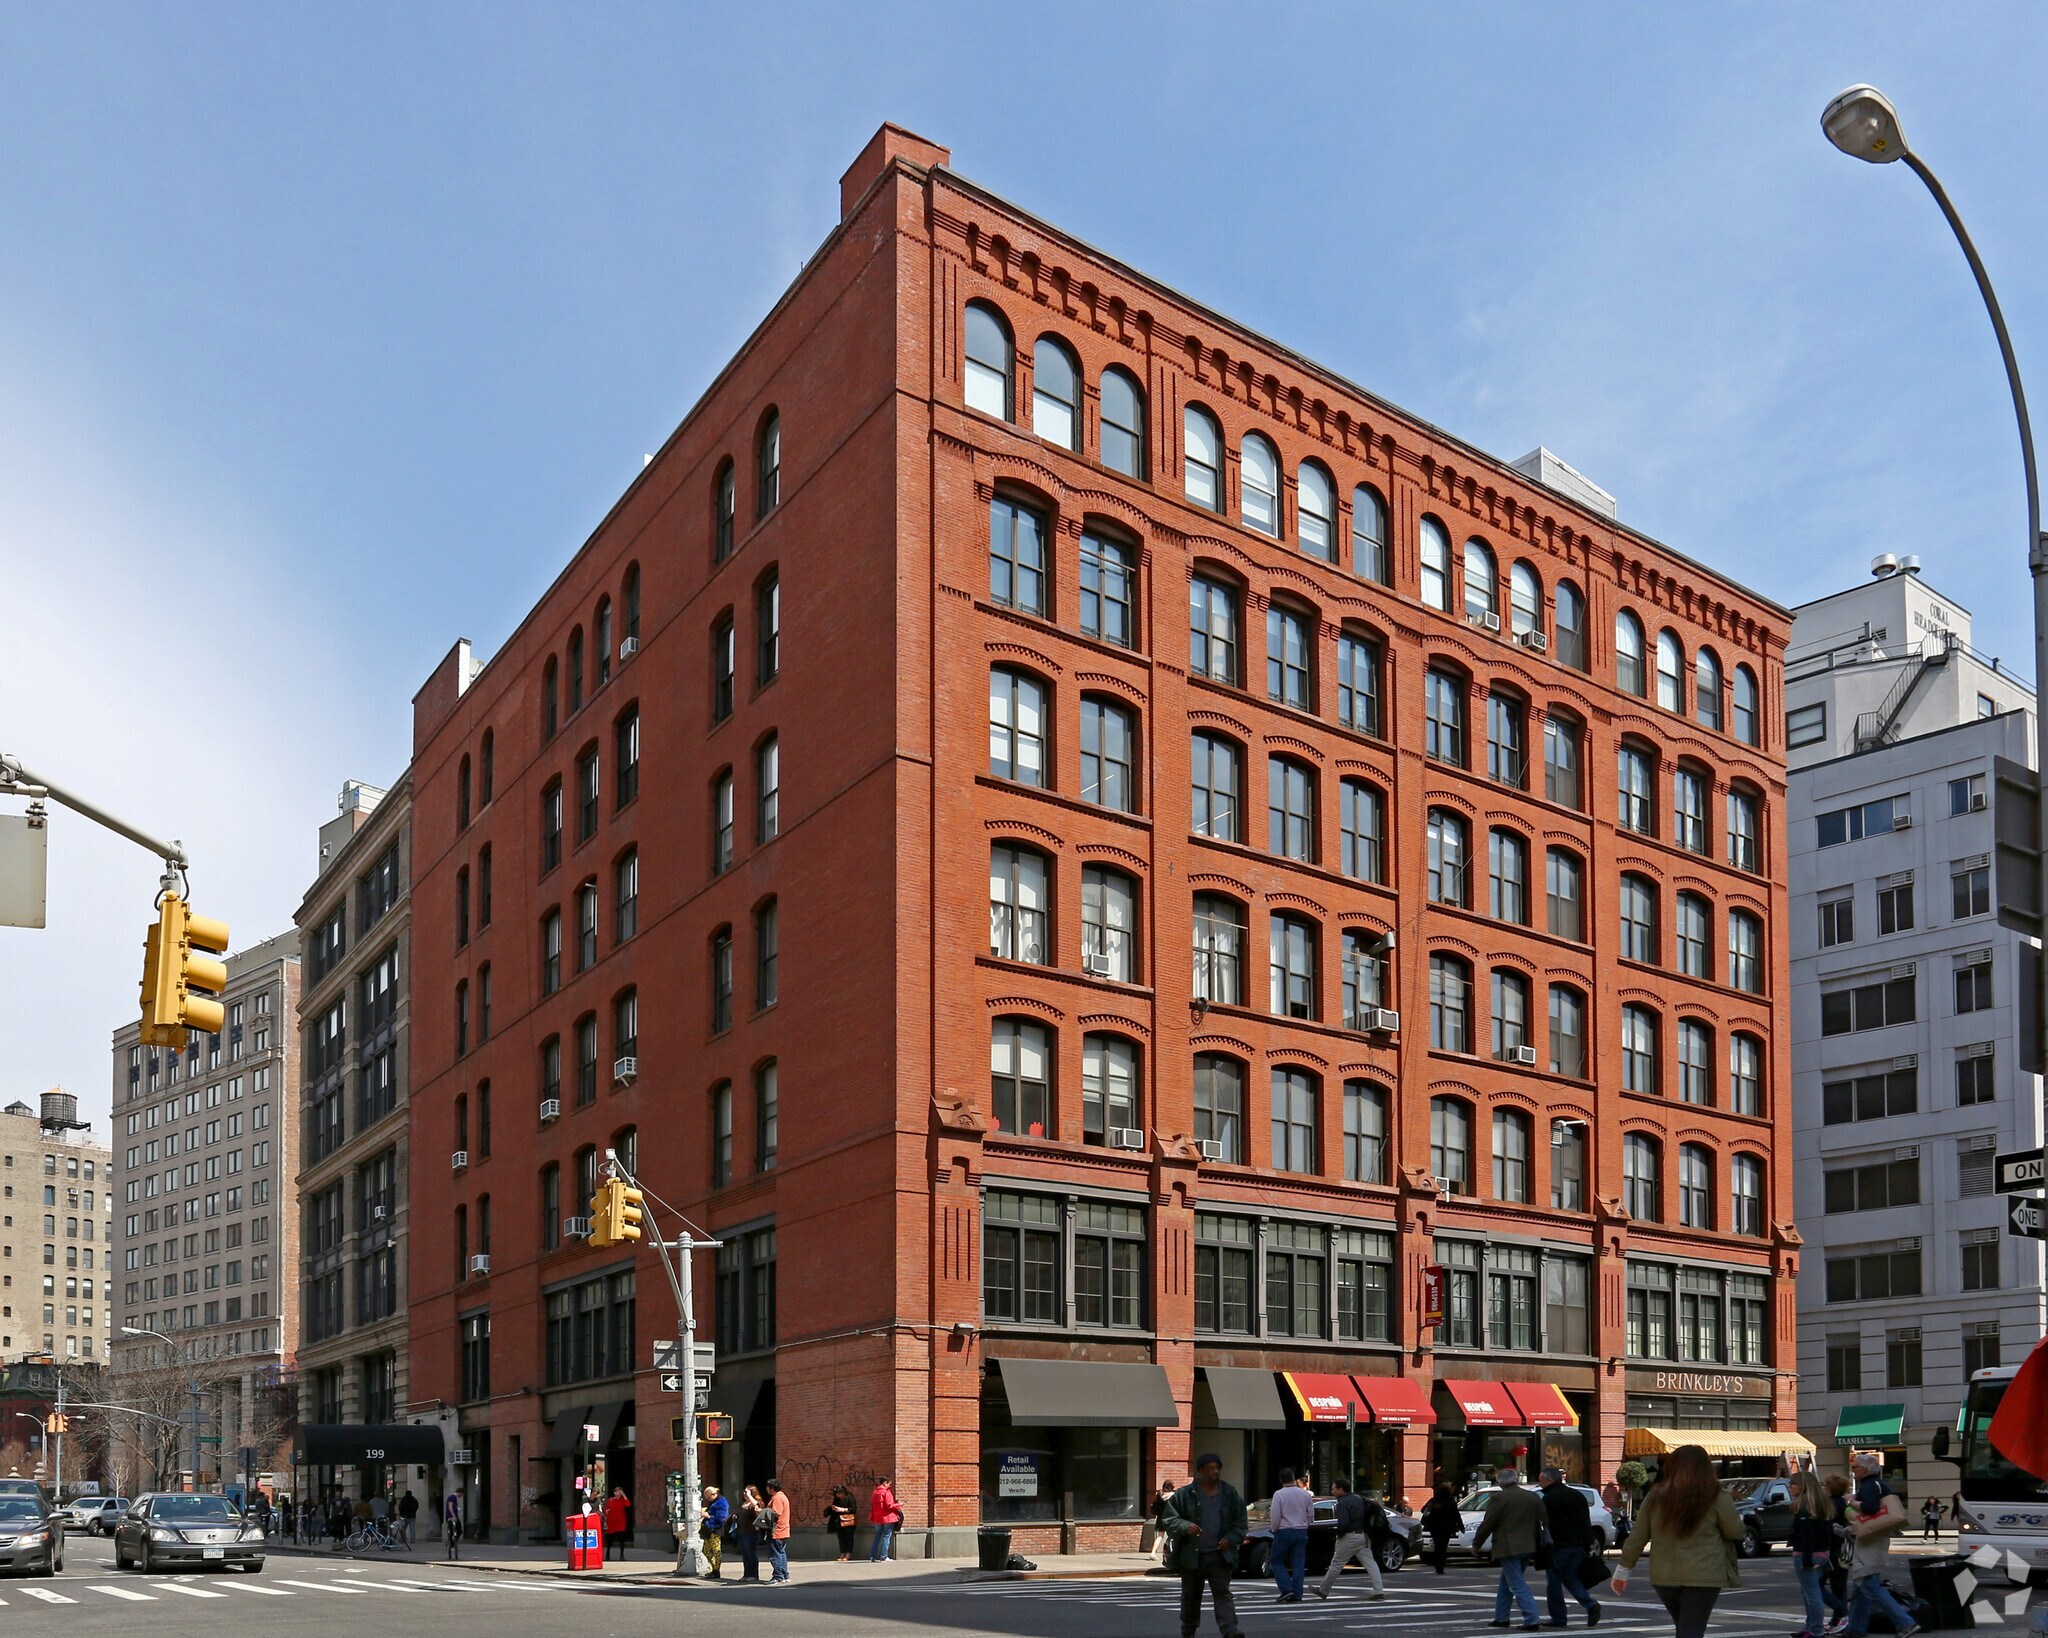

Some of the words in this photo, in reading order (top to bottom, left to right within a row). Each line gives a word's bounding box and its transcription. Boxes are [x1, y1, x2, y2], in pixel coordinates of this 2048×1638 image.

[1930, 602, 1950, 627] CORAL
[2015, 1161, 2041, 1179] ON
[2018, 1208, 2038, 1226] ONE
[1656, 1372, 1743, 1393] BRINKLEY'S
[366, 1449, 385, 1458] 199
